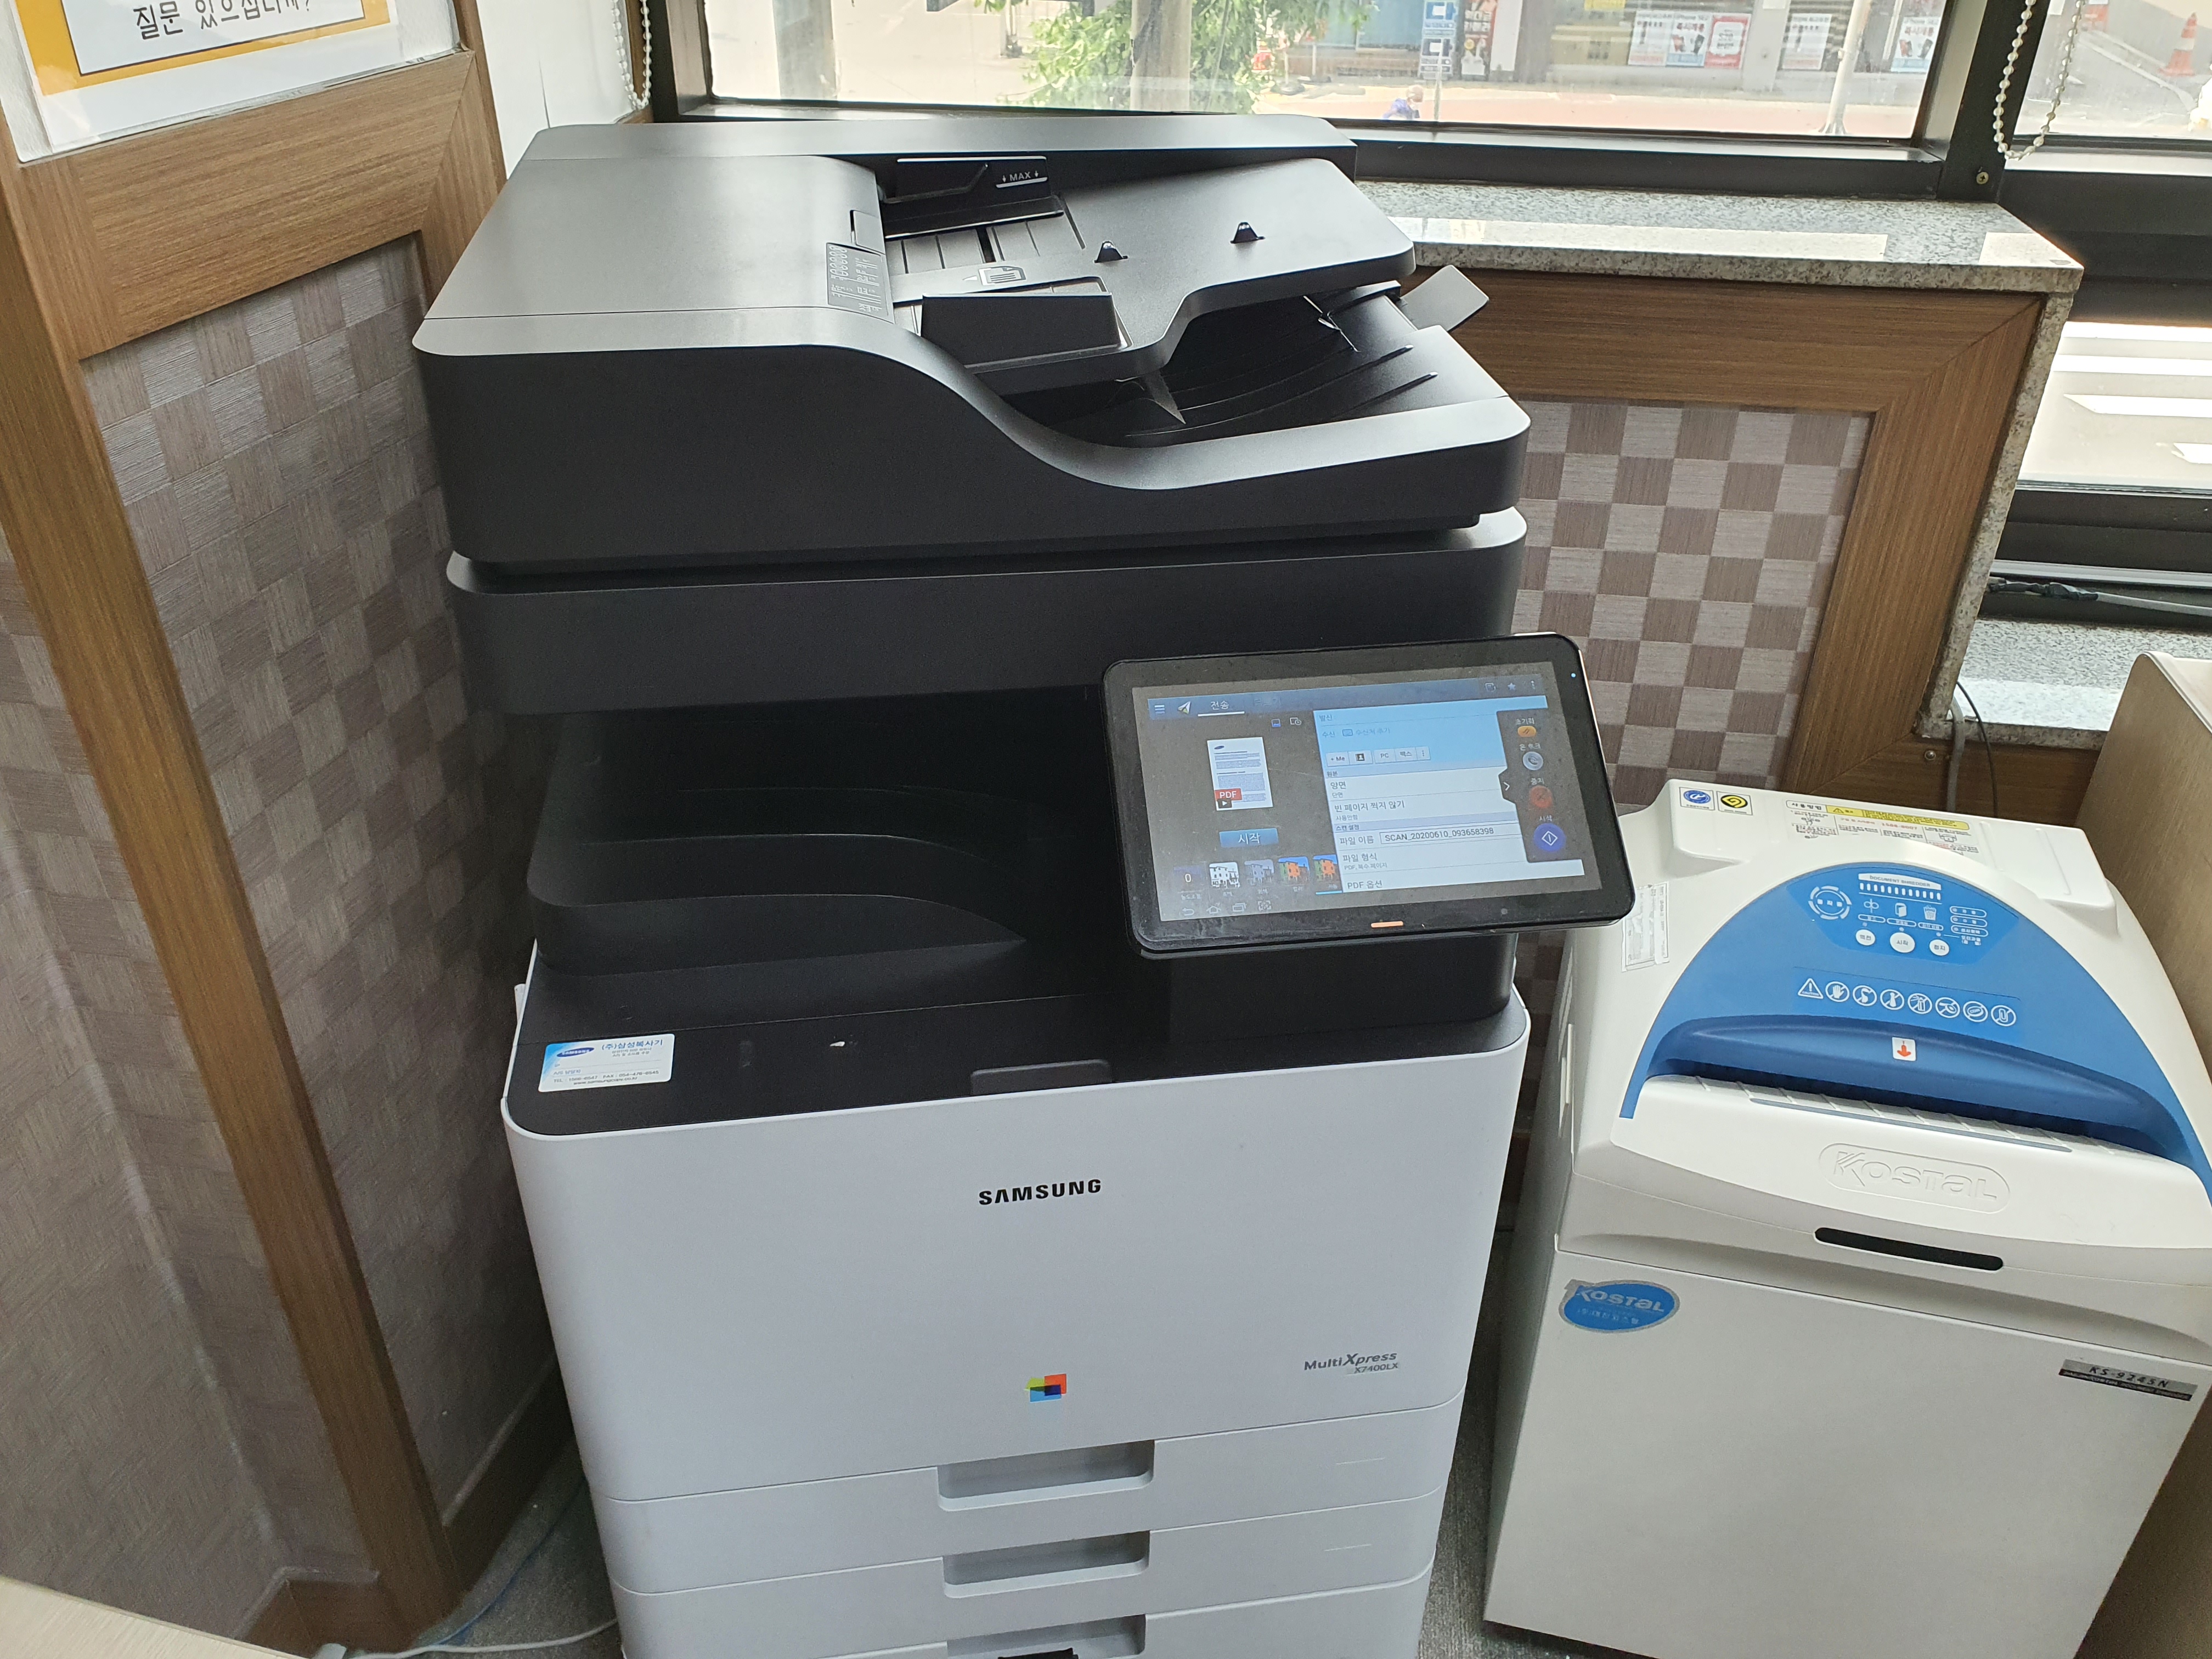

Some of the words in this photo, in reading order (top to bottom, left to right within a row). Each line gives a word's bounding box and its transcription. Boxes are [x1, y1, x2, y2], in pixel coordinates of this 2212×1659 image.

[133, 1, 183, 40] 질문
[1009, 171, 1031, 182] MAX
[1210, 699, 1229, 710] 전송
[1330, 781, 1346, 790] 양면
[1219, 791, 1237, 799] PDF
[1334, 804, 1342, 812] 빈
[1345, 803, 1368, 812] 페이지
[1388, 800, 1405, 810] 않기
[1238, 832, 1261, 845] 시작
[1340, 837, 1356, 845] 파일
[1358, 836, 1374, 844] 이름
[1385, 827, 1494, 842] SCAN_20200610_093658398
[1343, 854, 1358, 863] 파일
[1361, 853, 1378, 861] 형식
[1184, 873, 1192, 883] 0
[1870, 875, 1900, 883] DOCUMENT
[1901, 879, 1931, 887] SHREDDER
[1366, 880, 1383, 889] 옵션
[601, 1039, 663, 1051] (주)삼성복사기
[979, 1178, 1101, 1205] SAMSUNG
[1304, 1352, 1398, 1371] MultiXpress
[1354, 1362, 1398, 1374] X7400LX
